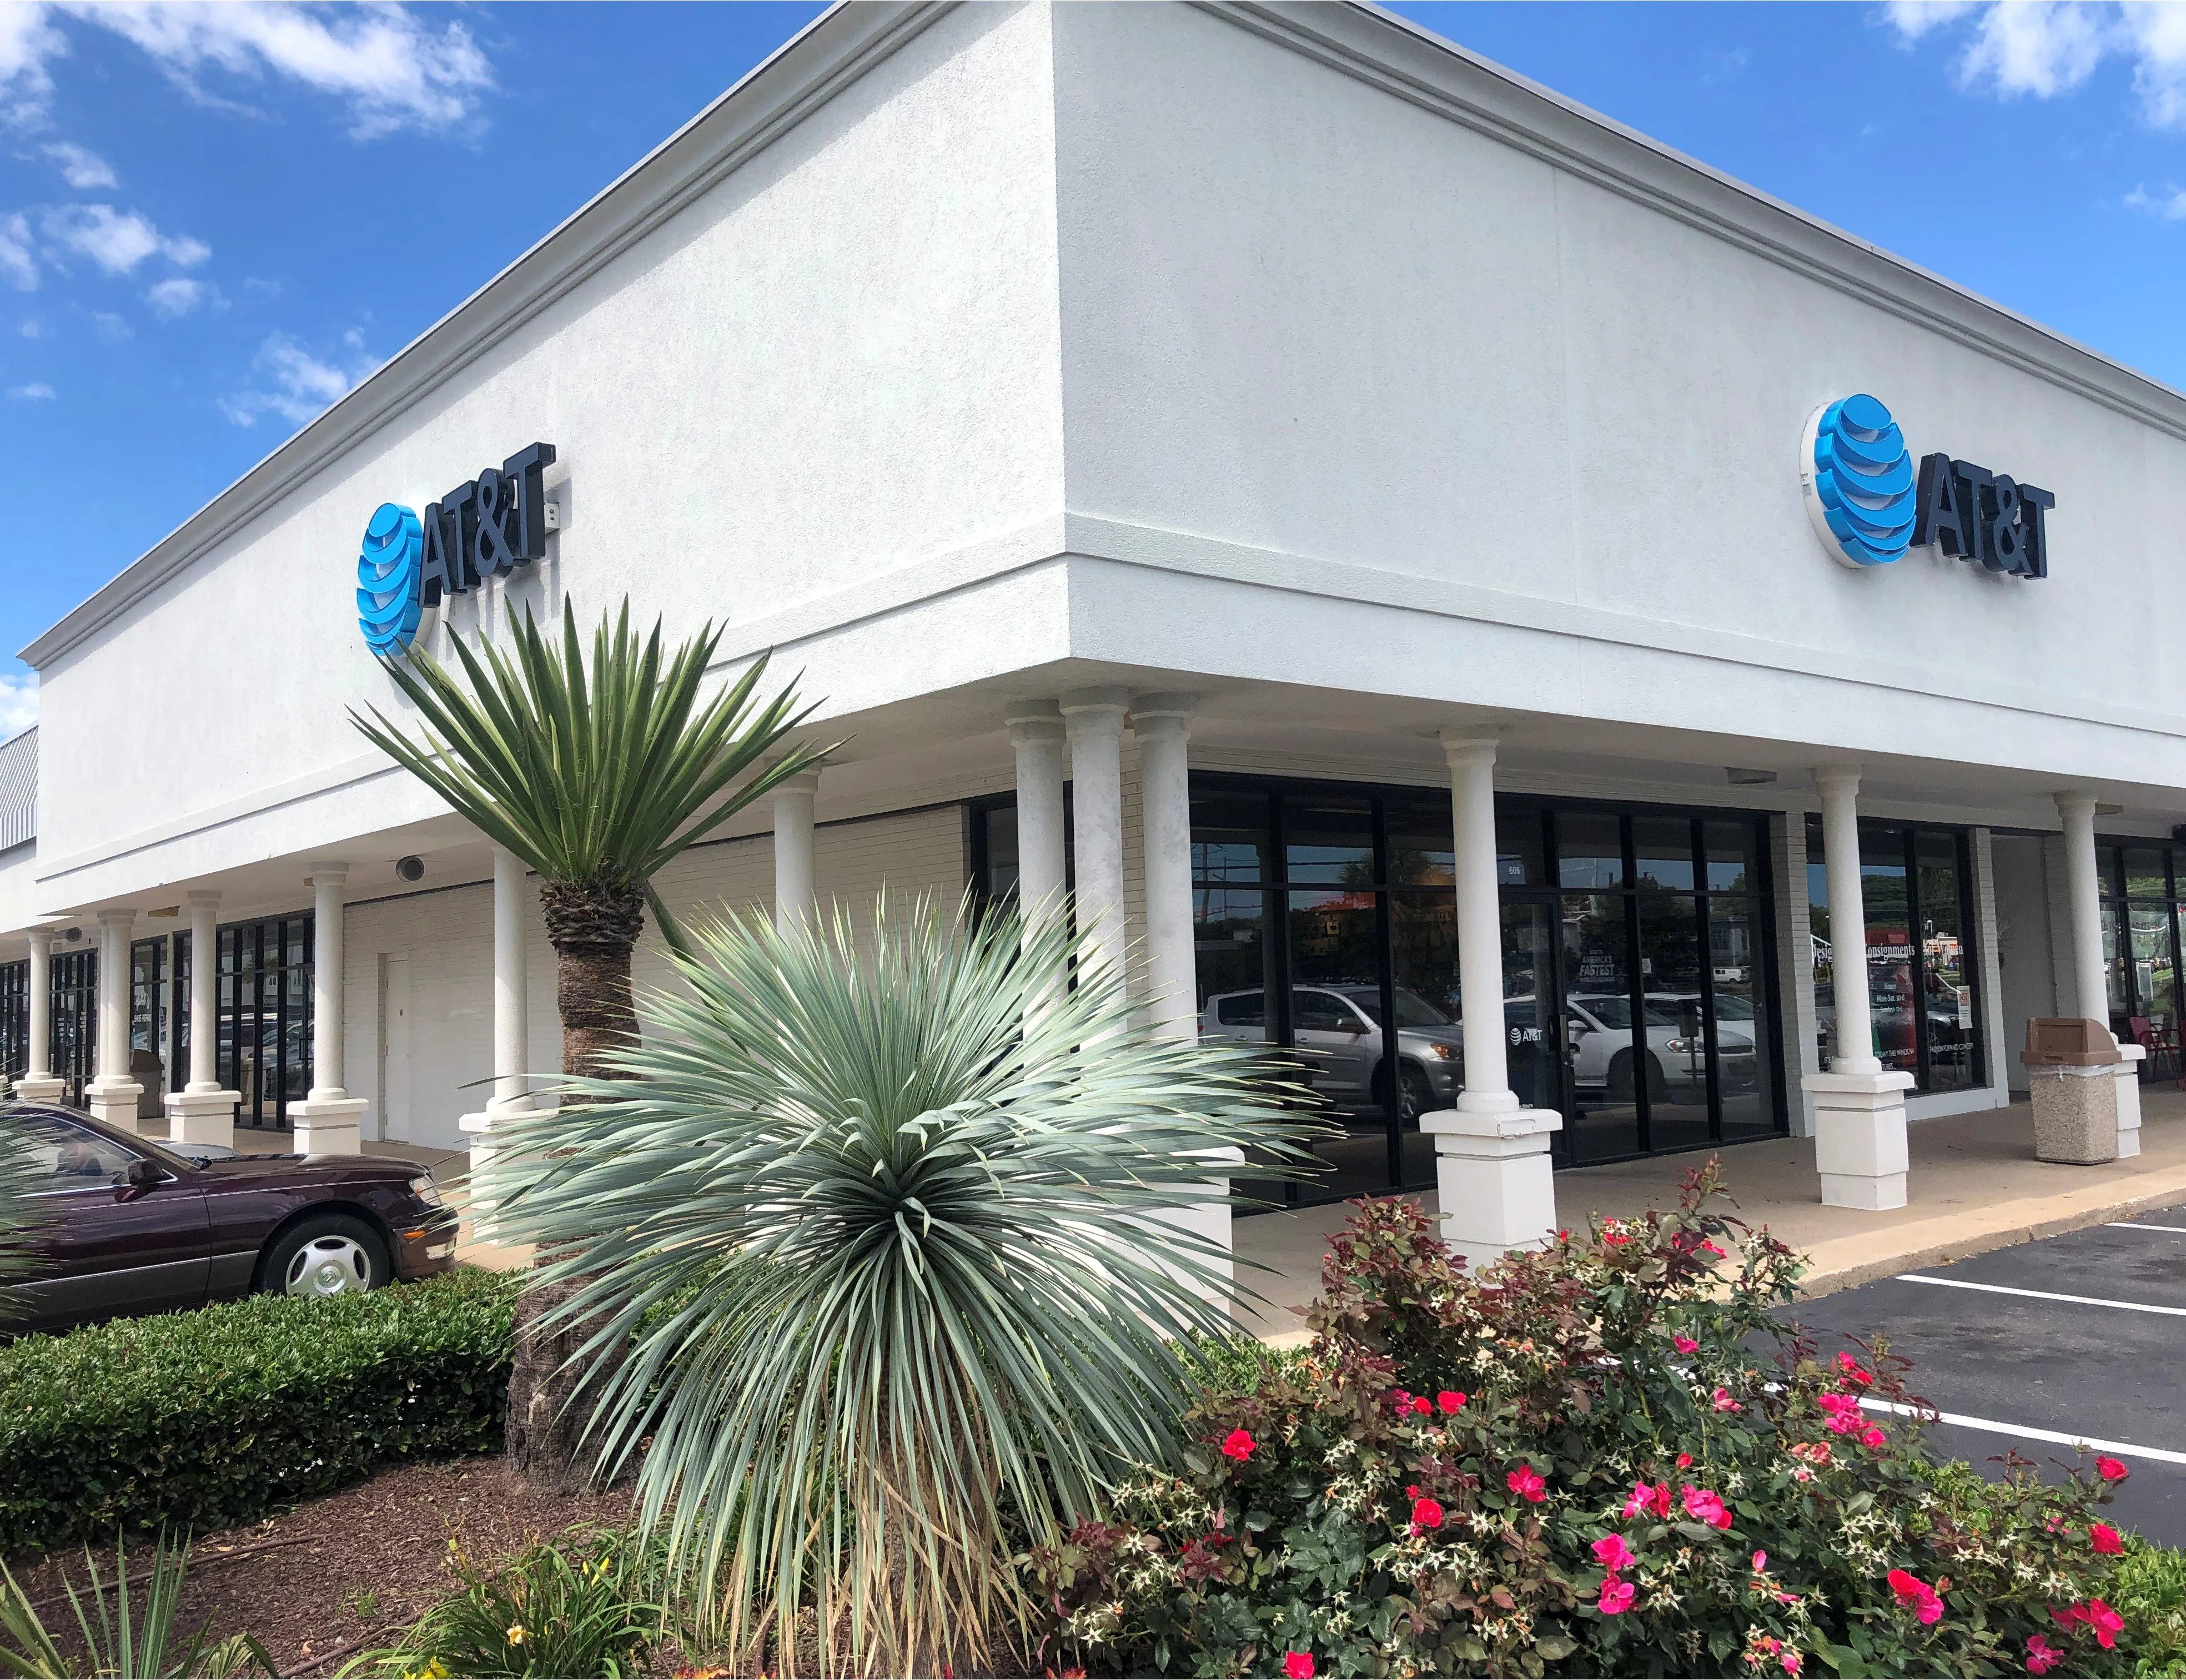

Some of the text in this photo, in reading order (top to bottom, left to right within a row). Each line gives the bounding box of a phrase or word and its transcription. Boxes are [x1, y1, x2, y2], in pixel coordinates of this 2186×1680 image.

[1909, 452, 2056, 580] AT&T
[418, 442, 556, 608] AT&T
[1509, 866, 1520, 875] 606
[1812, 944, 1832, 962] Desig
[1580, 964, 1615, 976] FASTEST
[1522, 1028, 1542, 1042] AT&T
